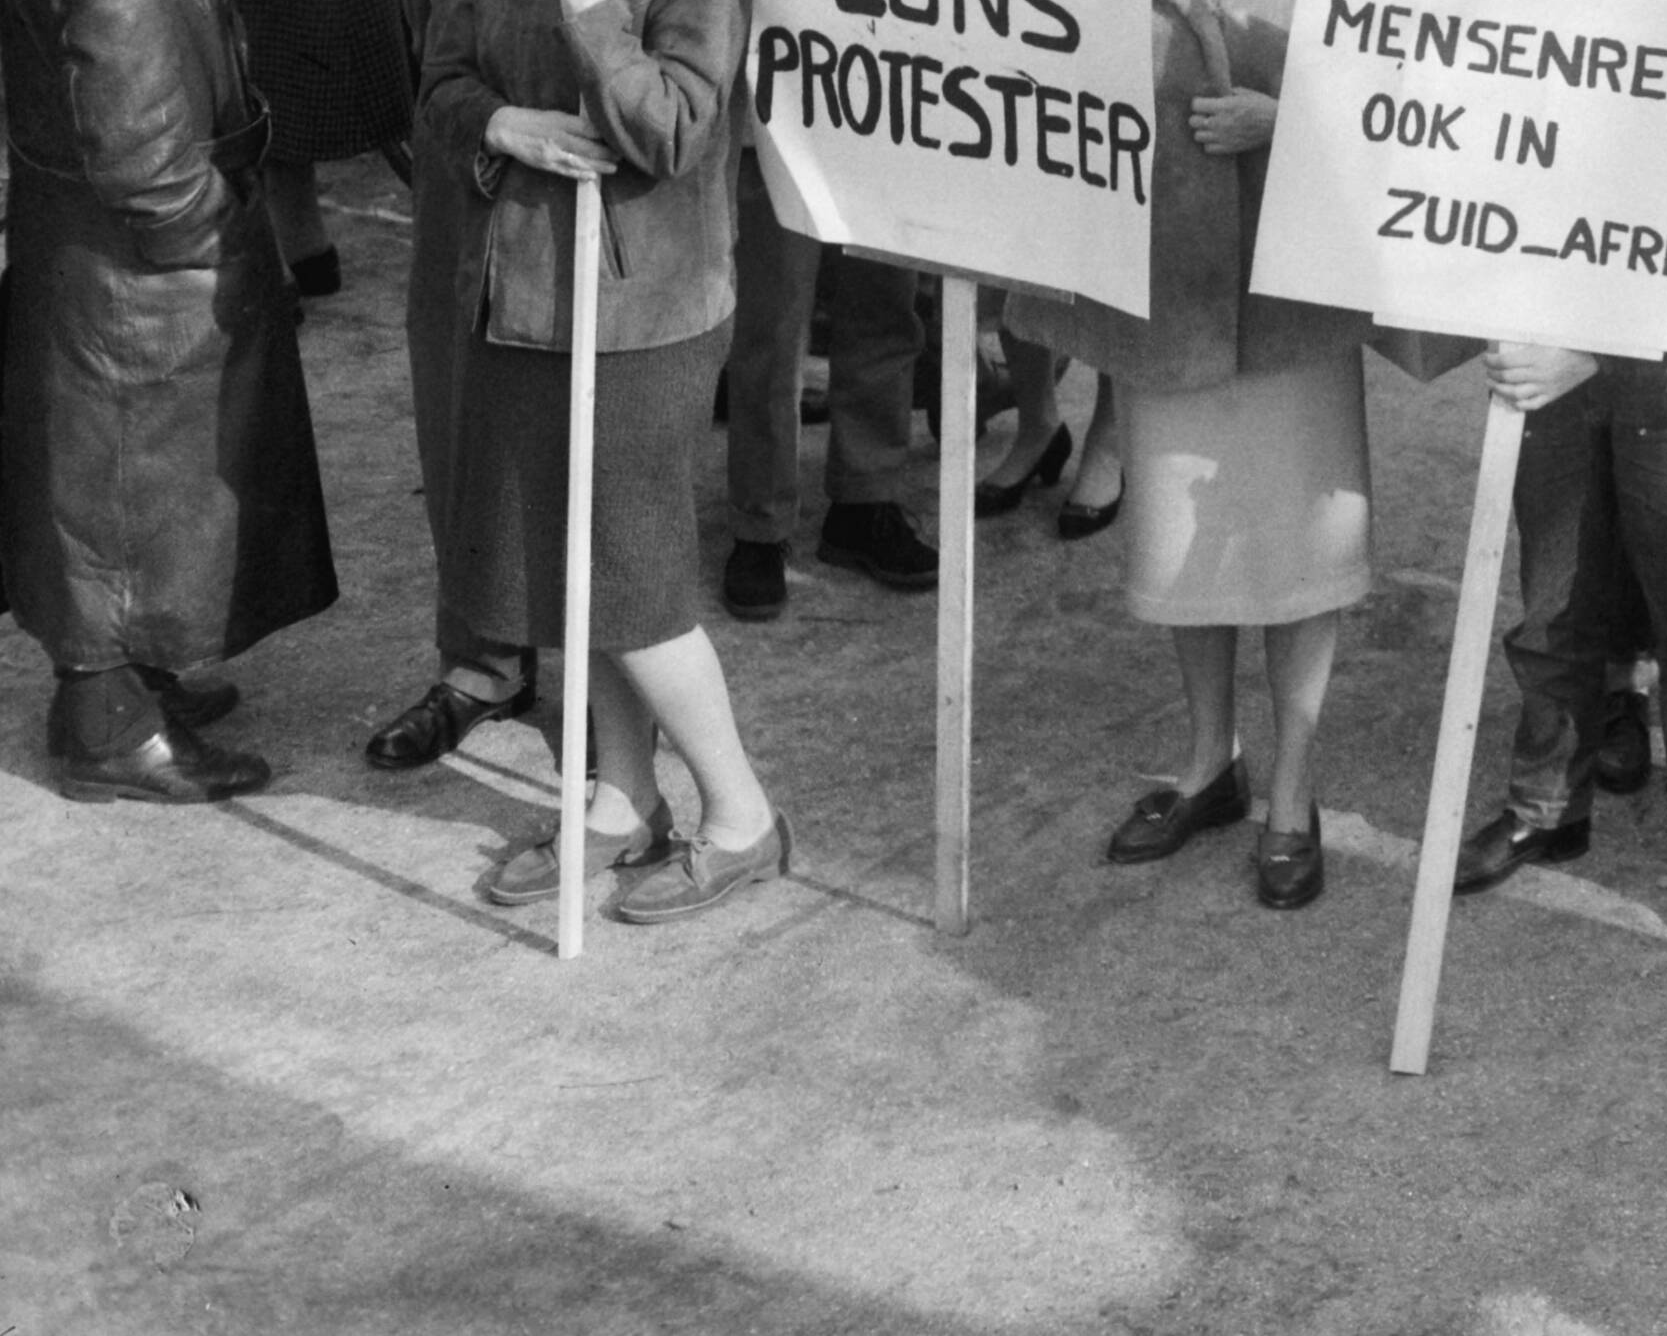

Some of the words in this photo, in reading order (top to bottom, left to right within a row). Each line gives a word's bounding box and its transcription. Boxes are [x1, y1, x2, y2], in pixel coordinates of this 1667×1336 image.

[756, 26, 1151, 205] PROTESTEER
[1362, 92, 1467, 151] OOK
[1495, 112, 1559, 168] IN
